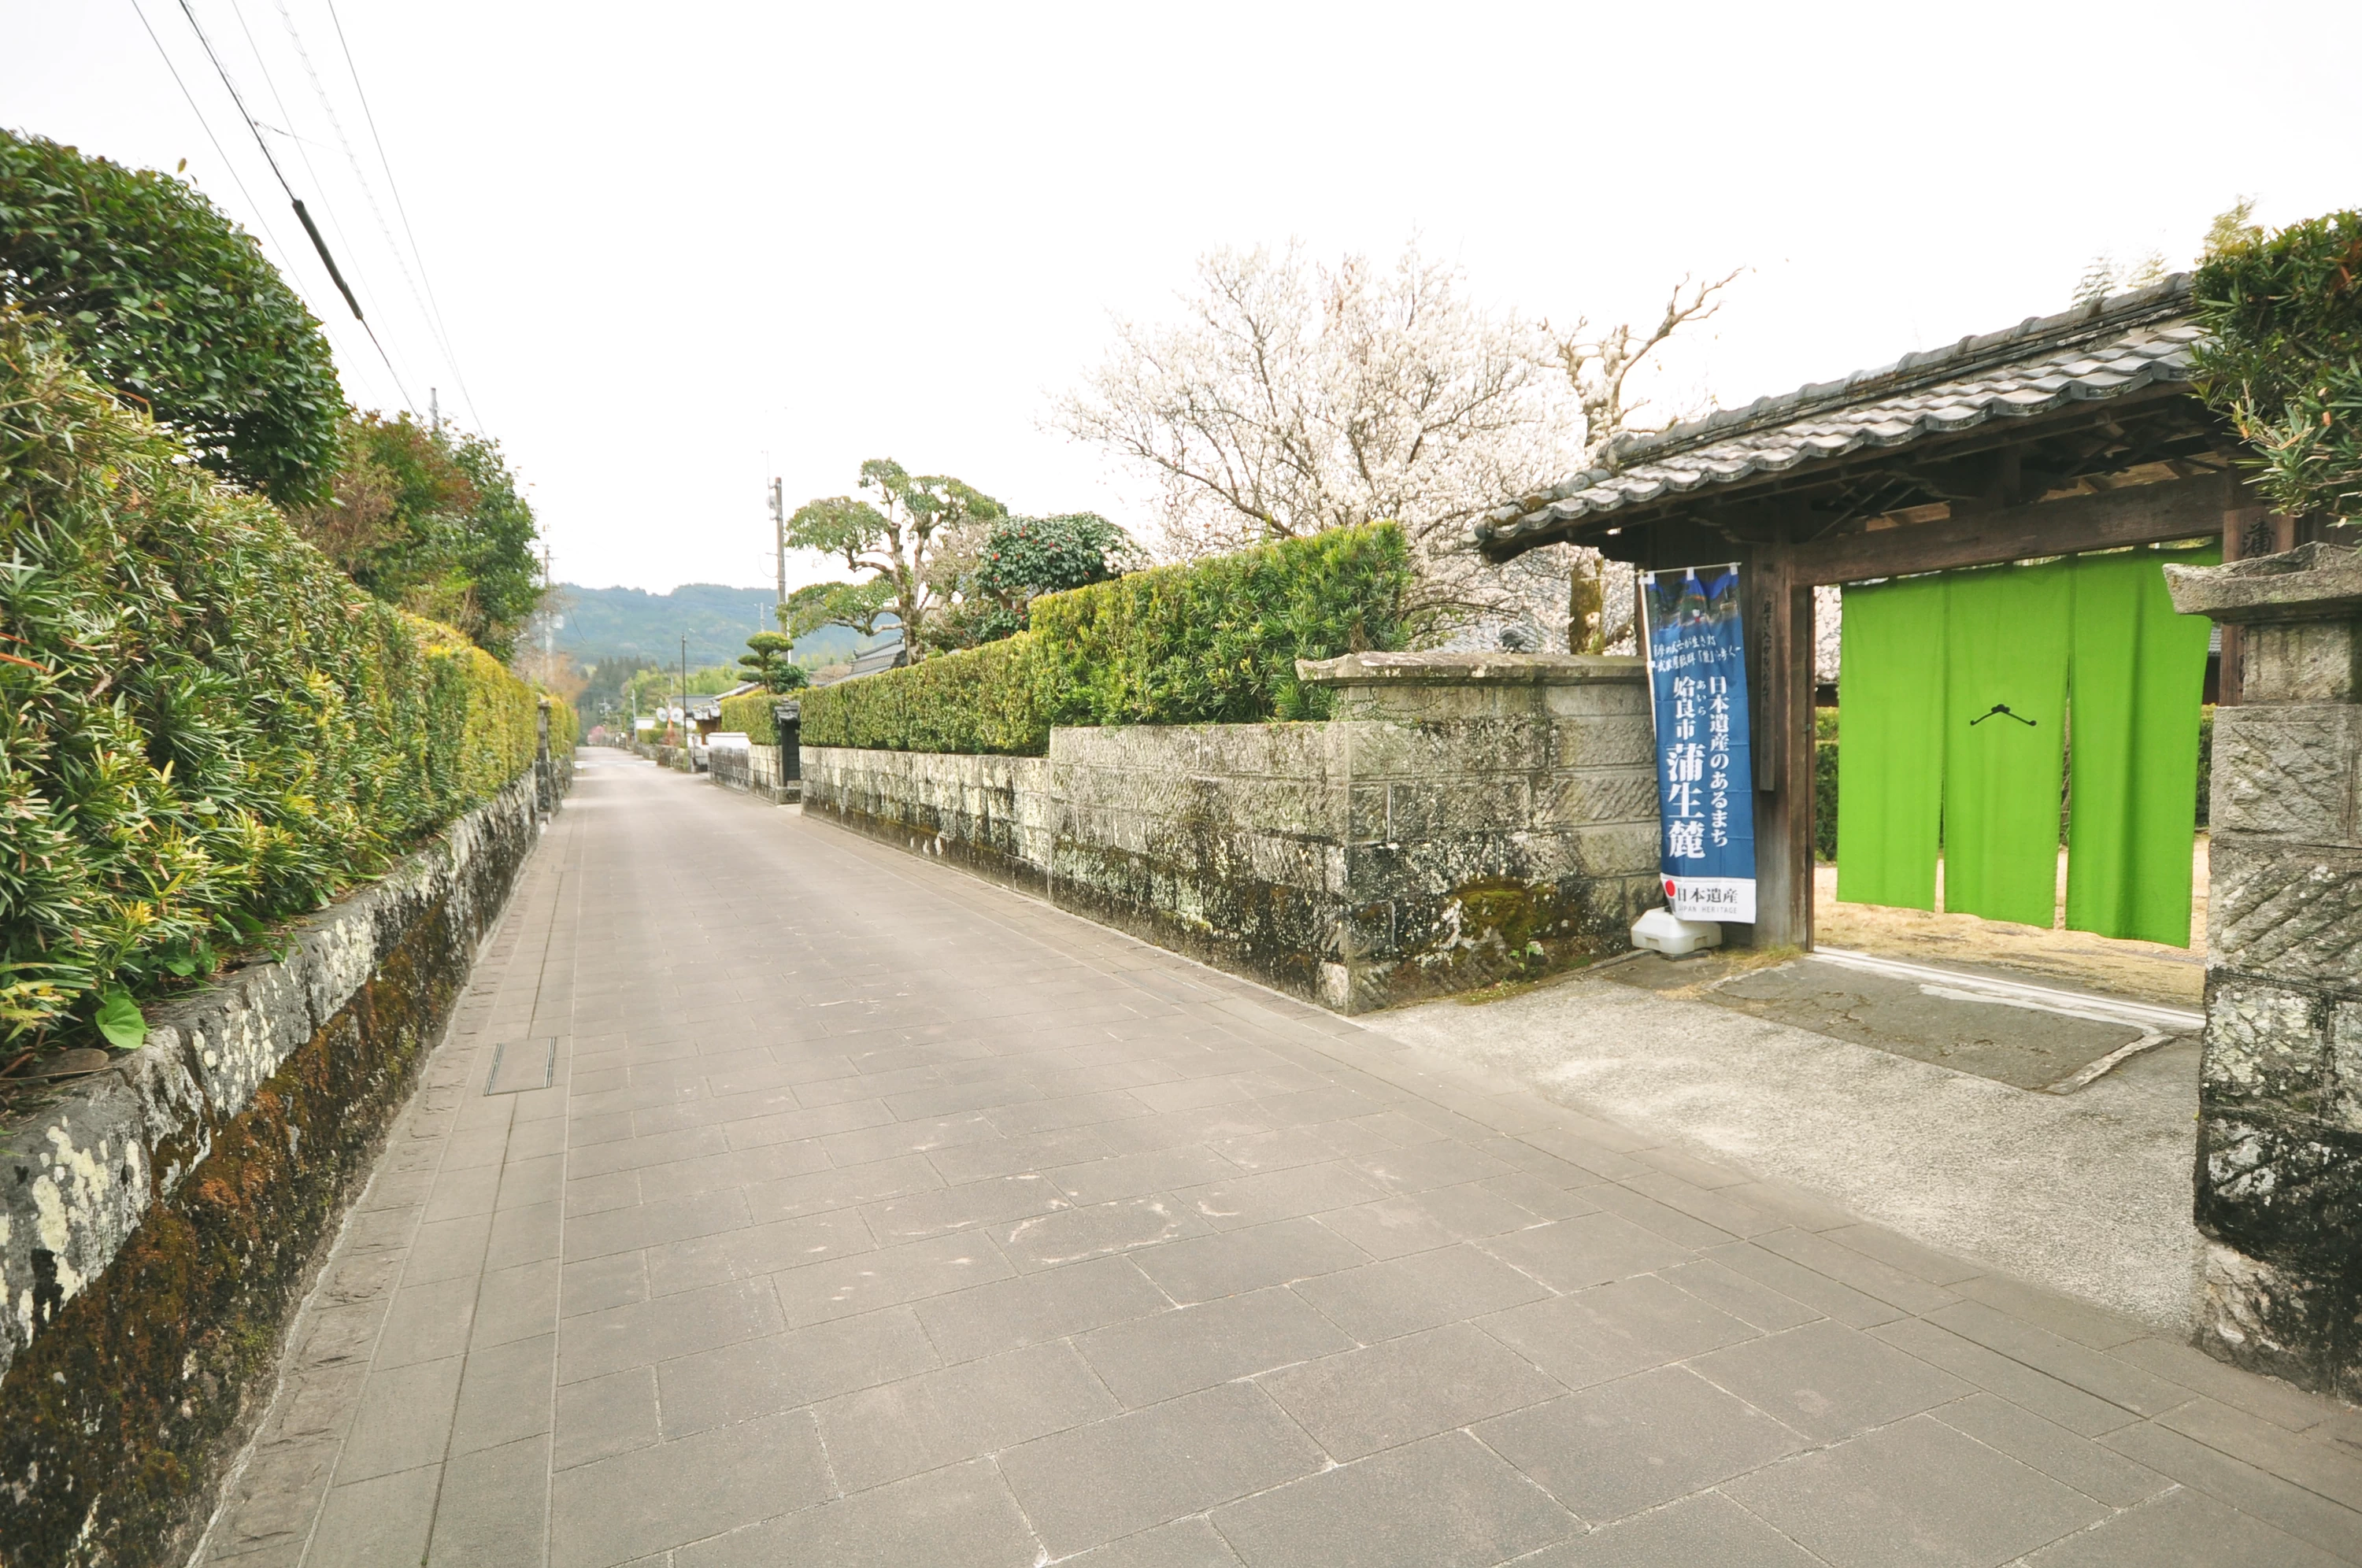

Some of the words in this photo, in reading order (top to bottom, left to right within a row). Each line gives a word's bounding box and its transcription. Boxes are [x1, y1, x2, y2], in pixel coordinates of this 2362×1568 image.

[1697, 679, 1707, 716] あいら
[1709, 676, 1730, 846] 日本遺産のあるまち
[1678, 888, 1738, 904] 日本遺産
